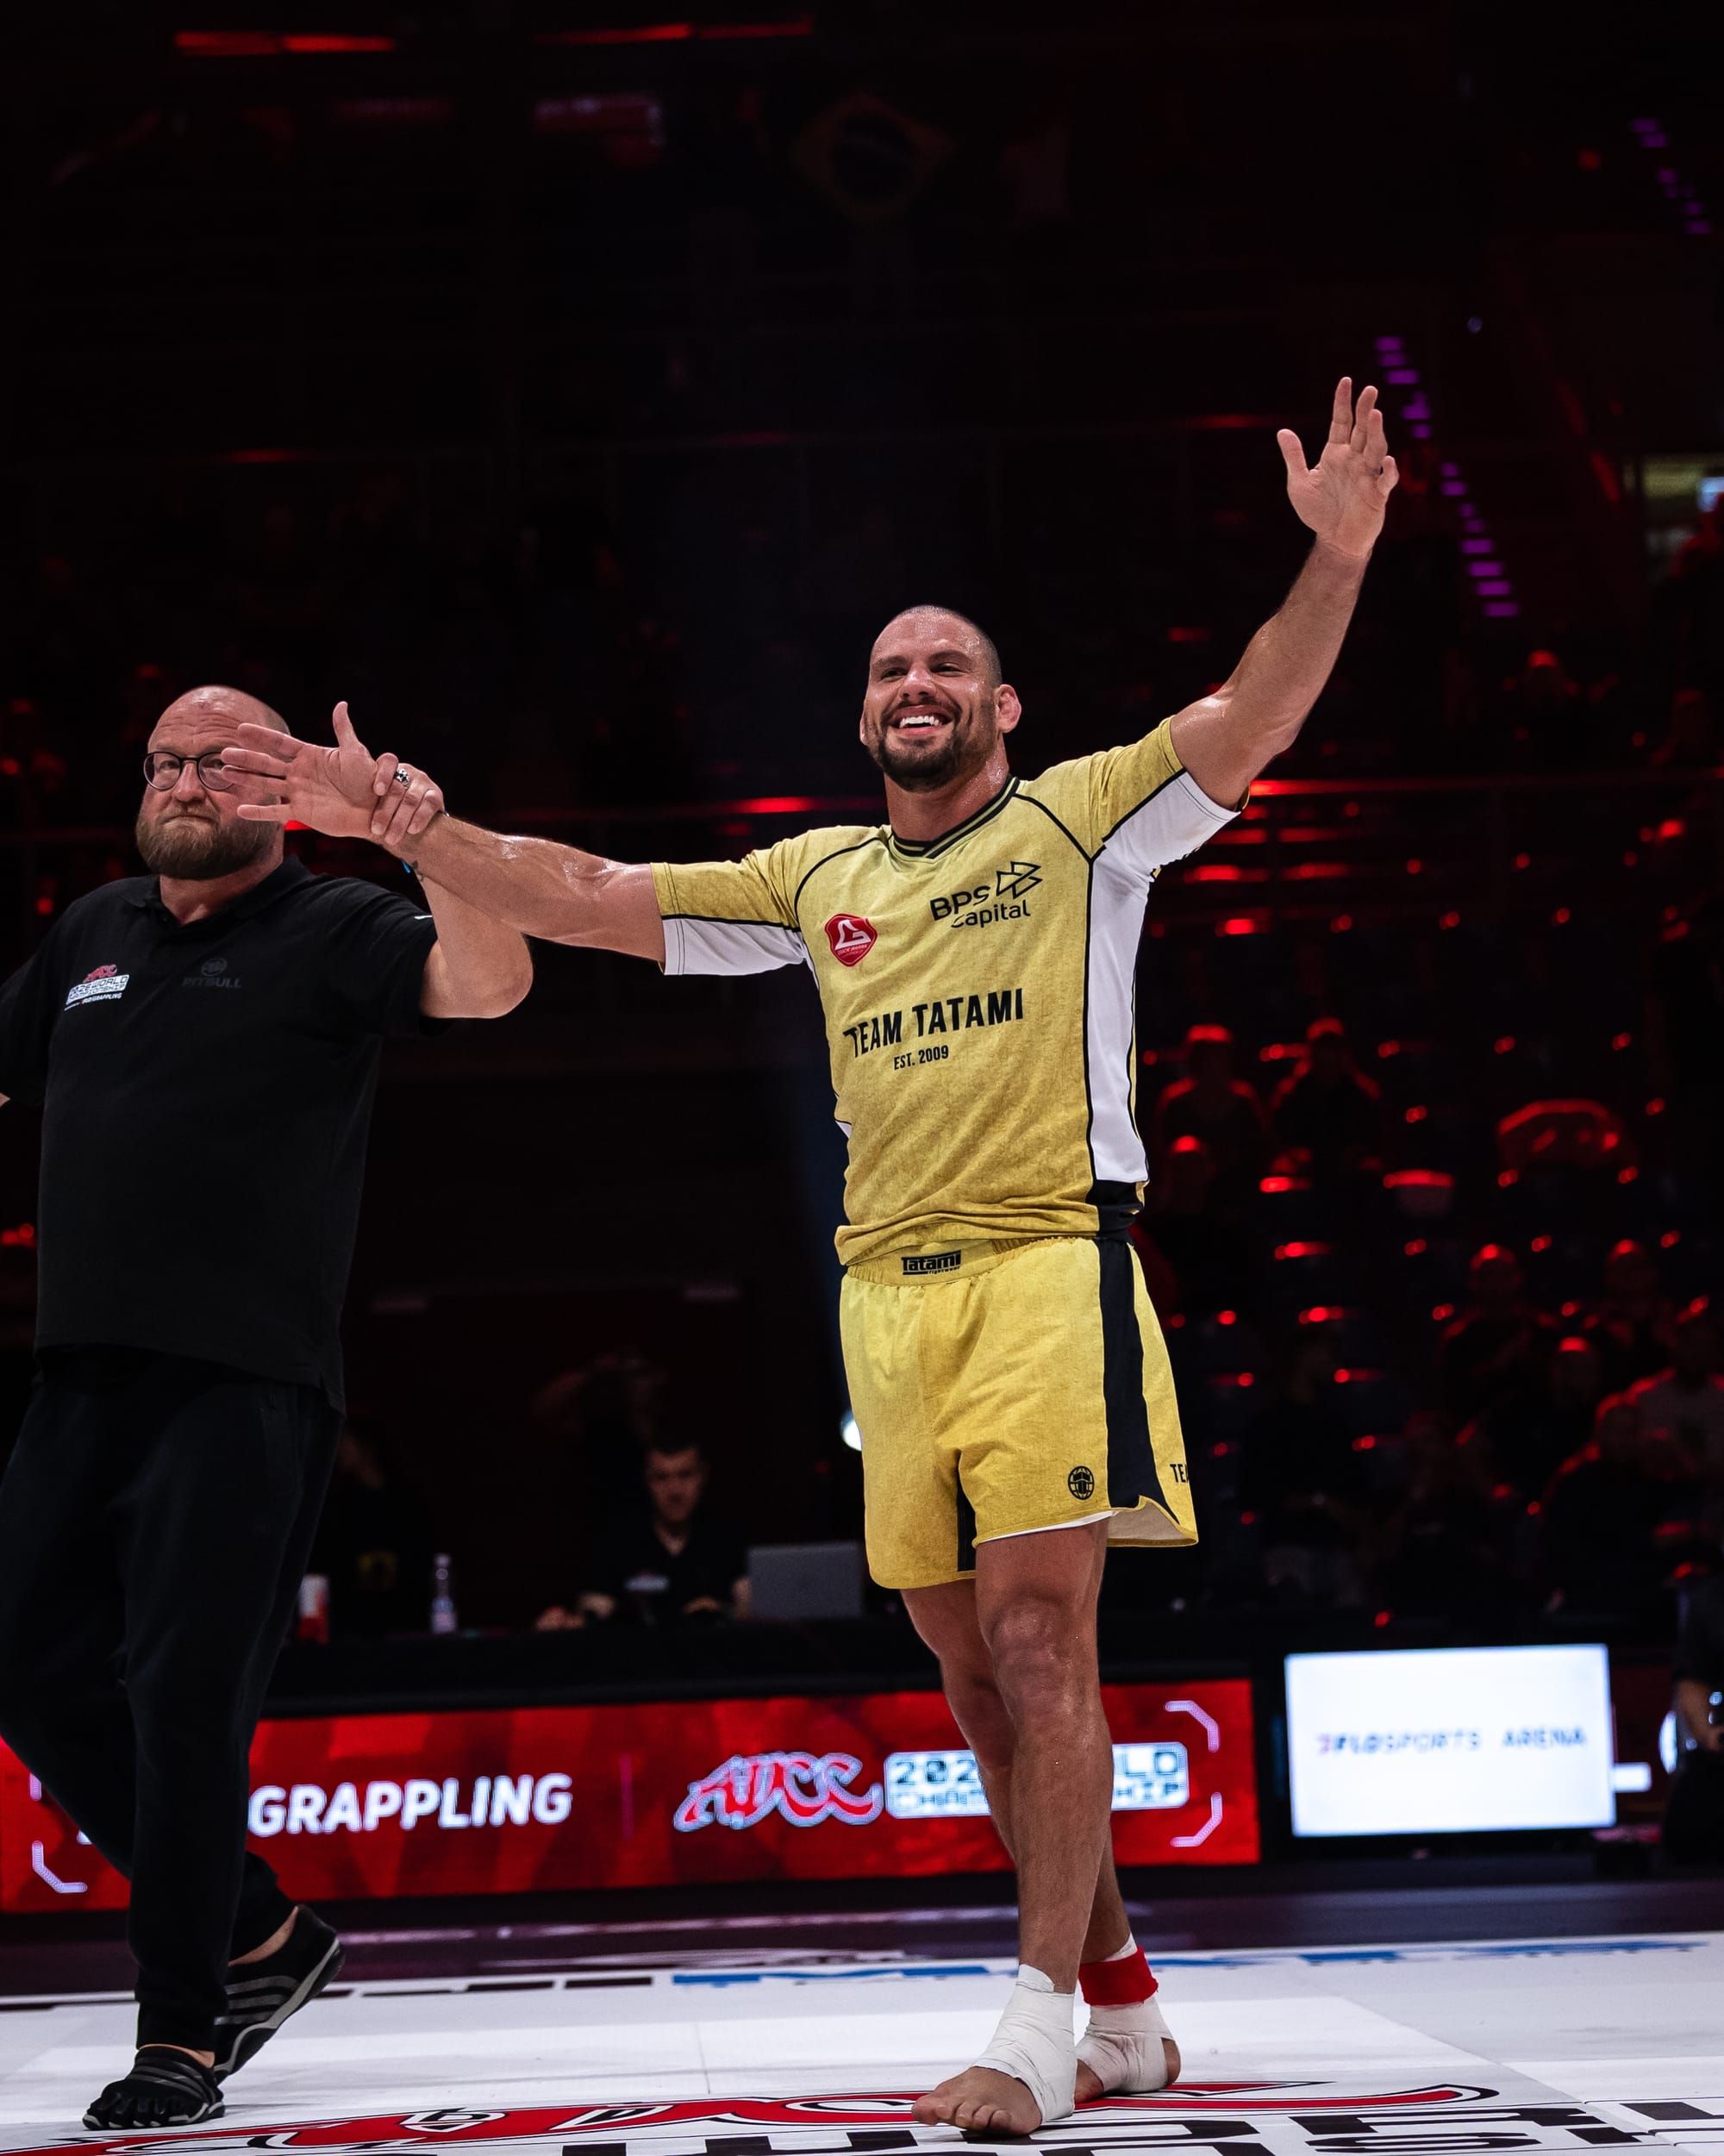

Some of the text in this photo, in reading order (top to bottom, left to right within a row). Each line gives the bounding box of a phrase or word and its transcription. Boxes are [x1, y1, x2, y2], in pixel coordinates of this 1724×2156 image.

[930, 885, 991, 921] BPS
[951, 900, 1031, 928] capital
[843, 988, 1024, 1058] TEAM TATAMI
[894, 1045, 949, 1070] EST. 2009
[901, 1249, 961, 1272] Tatami
[1502, 1725, 1586, 1749] ARENA
